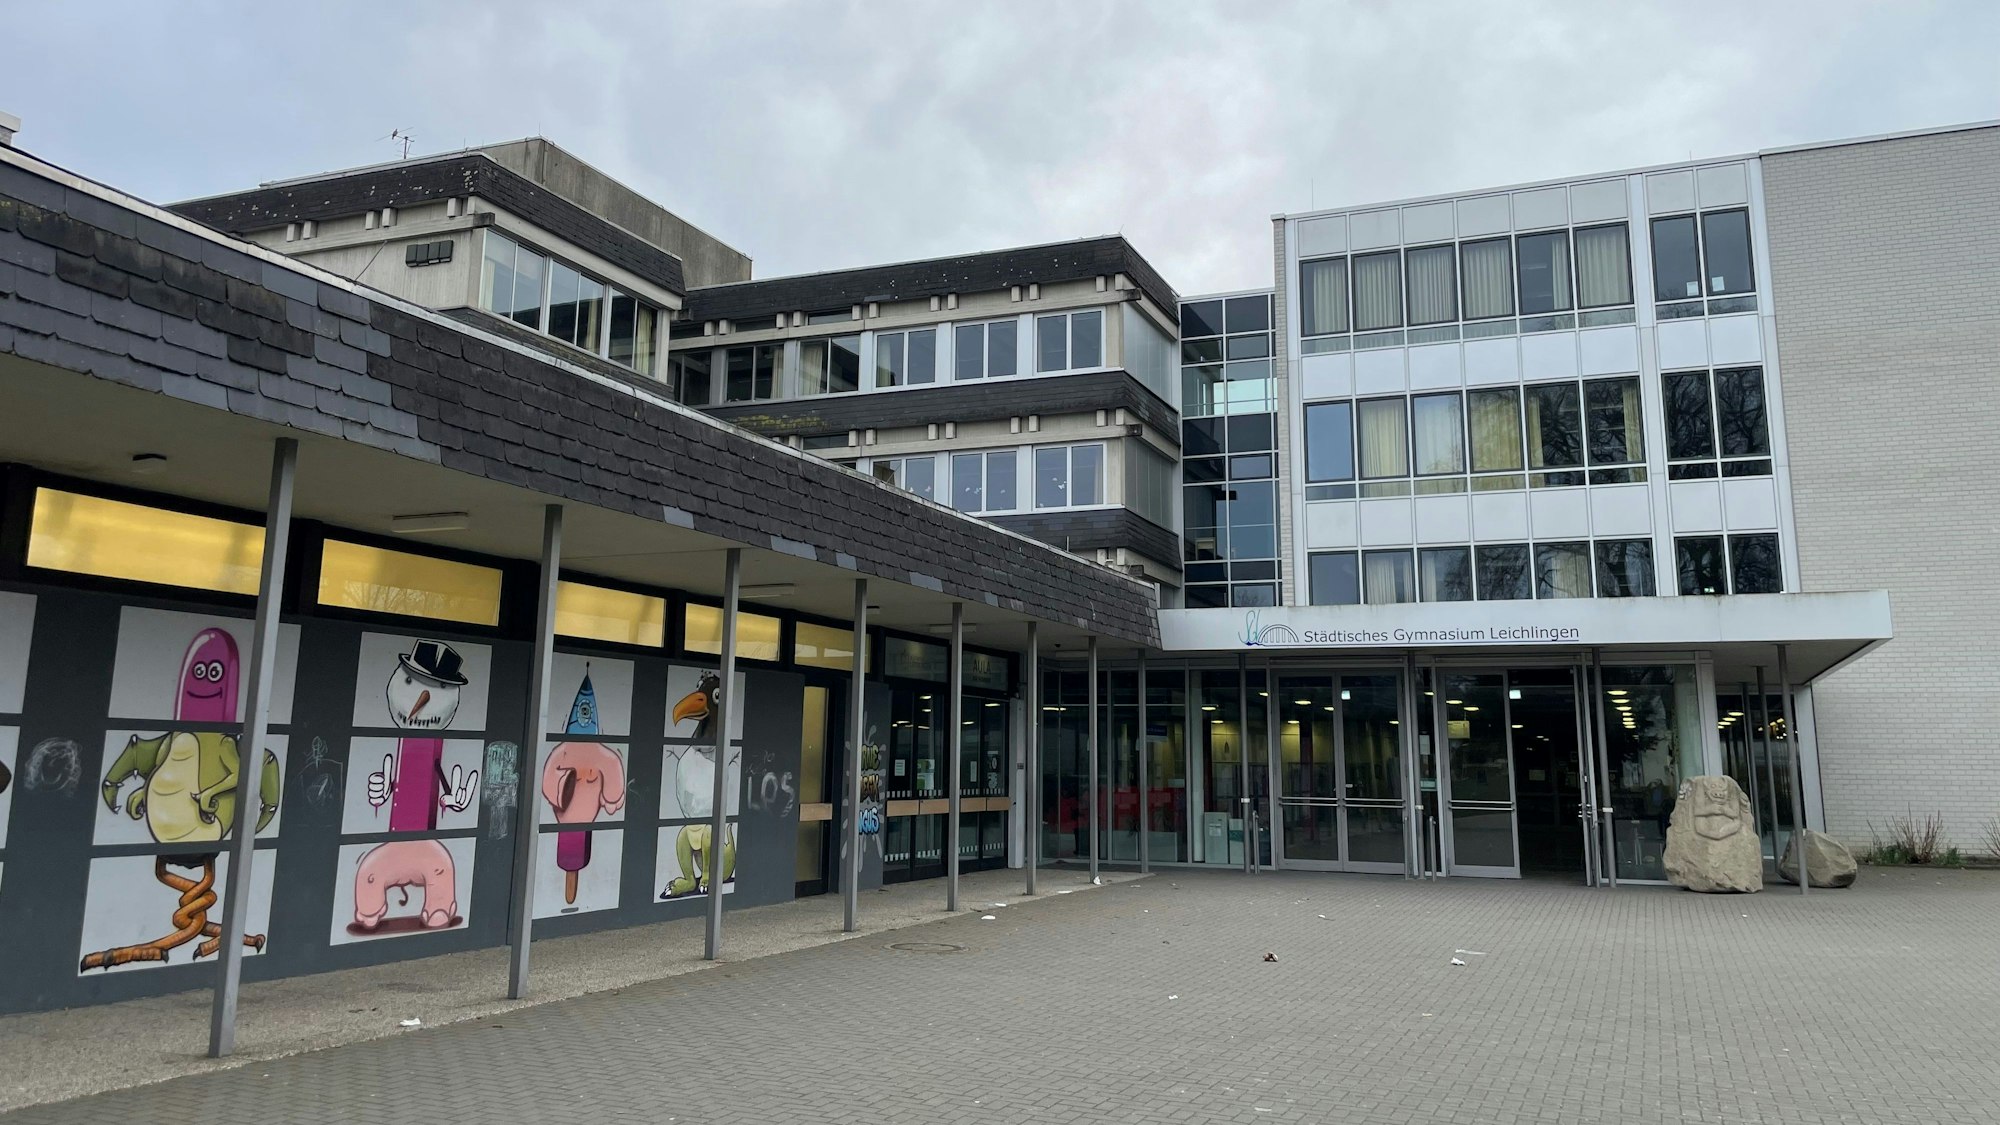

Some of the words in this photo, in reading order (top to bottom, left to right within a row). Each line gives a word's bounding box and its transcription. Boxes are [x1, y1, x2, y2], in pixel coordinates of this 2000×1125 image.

[1303, 629, 1388, 643] Städtisches
[1393, 627, 1484, 644] Gymnasium
[1490, 625, 1579, 642] Leichlingen
[972, 658, 991, 675] AULA
